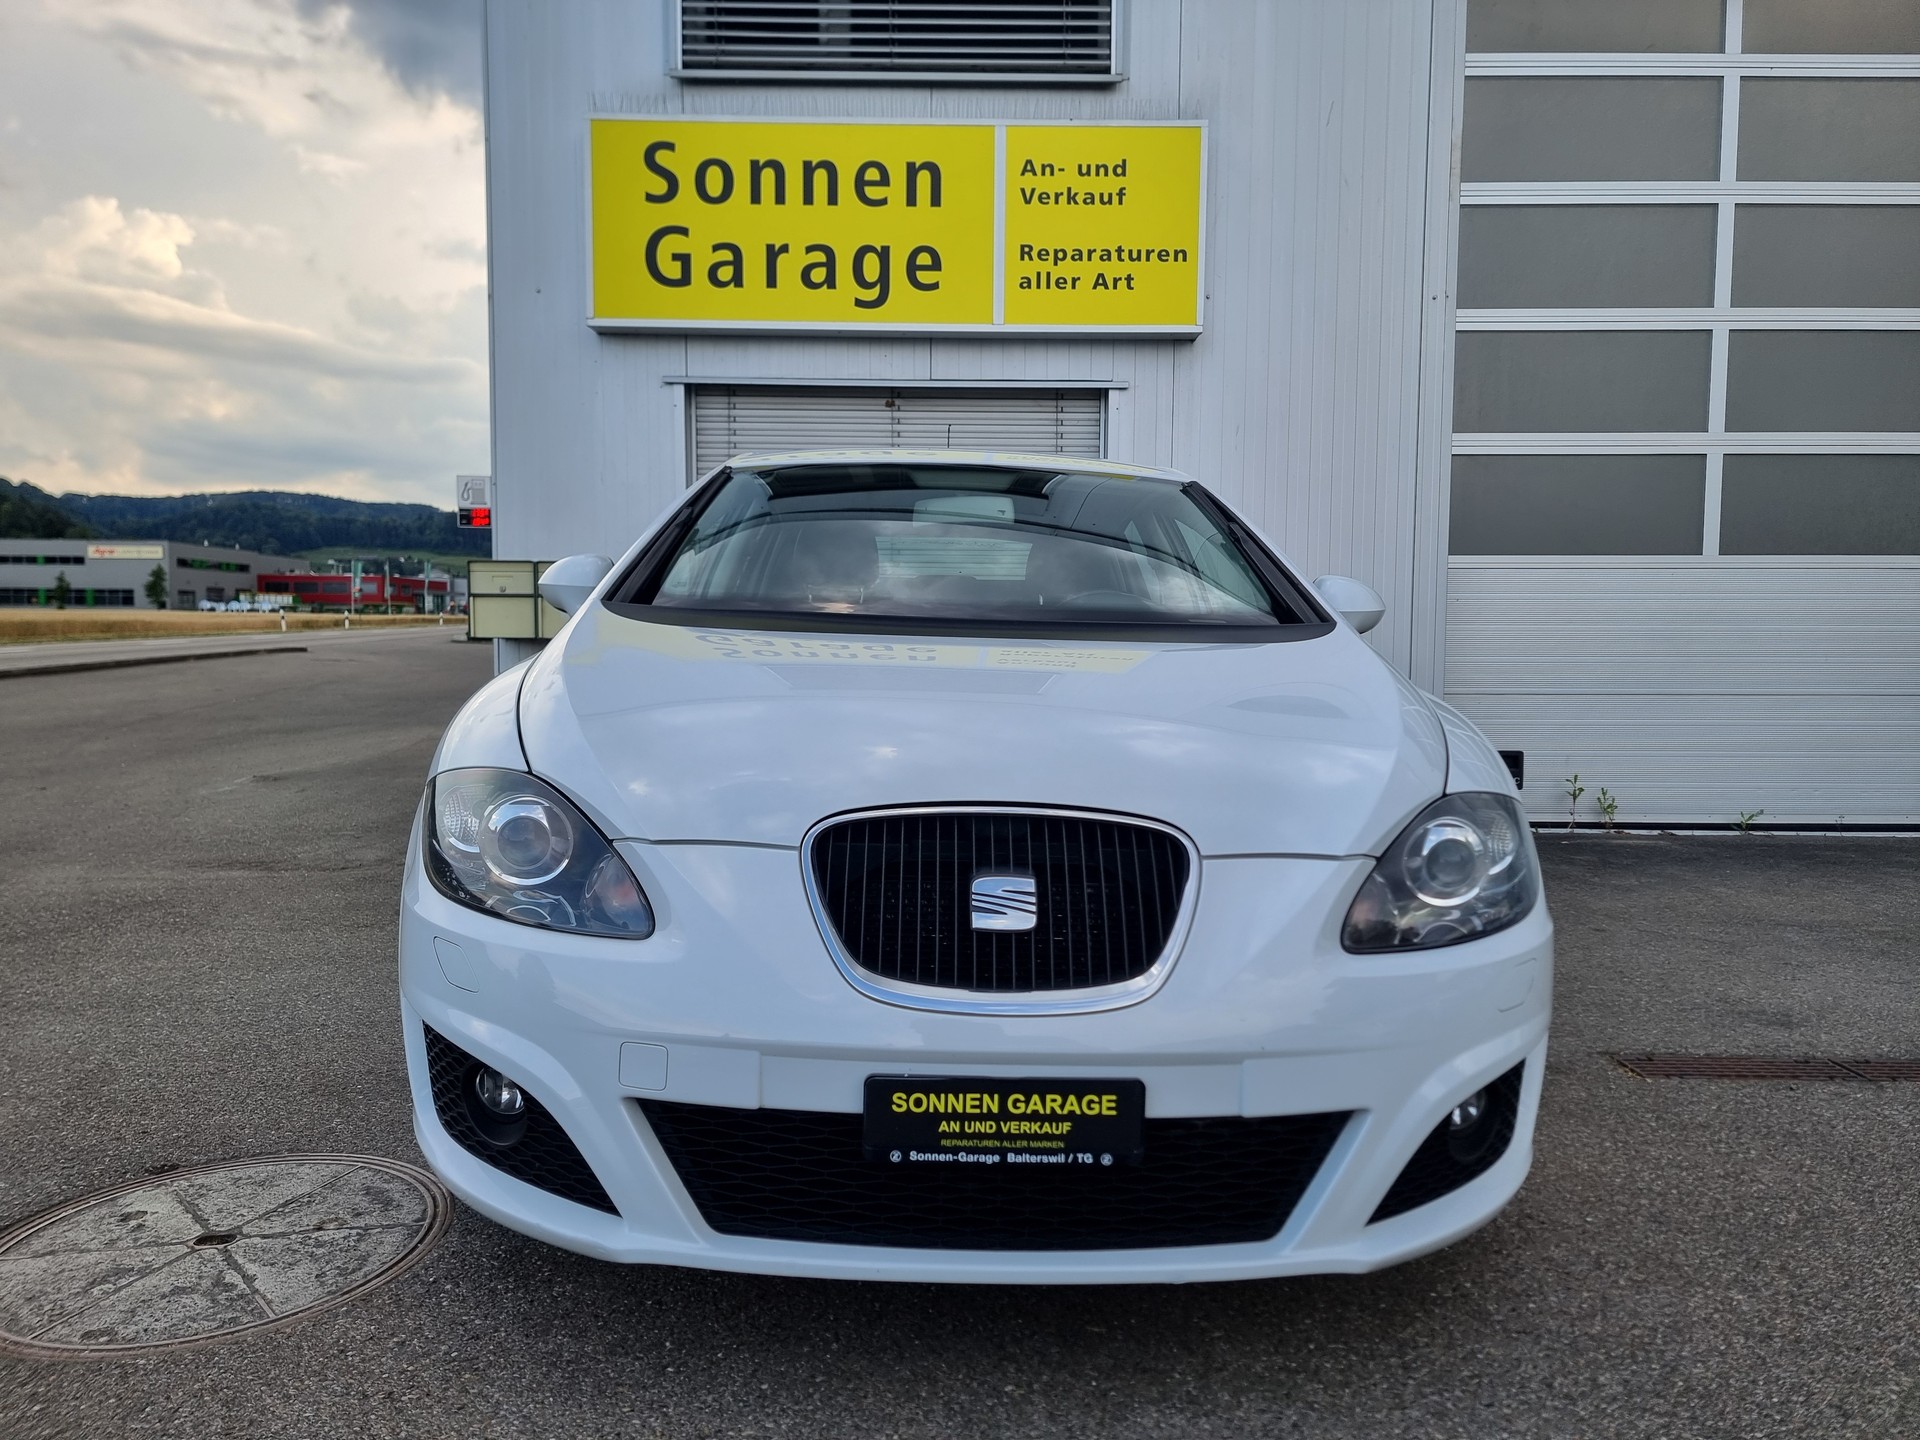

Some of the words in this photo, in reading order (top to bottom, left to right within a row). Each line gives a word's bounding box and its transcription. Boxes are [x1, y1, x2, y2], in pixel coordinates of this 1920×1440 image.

[643, 140, 942, 208] Sonnen
[1020, 159, 1066, 177] An-
[1077, 158, 1127, 178] und
[1019, 186, 1127, 206] Verkauf
[1019, 244, 1188, 266] Reparaturen
[644, 224, 943, 310] Garage
[1018, 271, 1081, 290] aller
[1091, 272, 1135, 291] Art
[891, 1092, 999, 1114] SONNEN
[1007, 1093, 1118, 1116] GARAGE
[938, 1120, 960, 1133] AN
[964, 1120, 997, 1134] UND
[1000, 1120, 1072, 1135] VERKAUF
[940, 1138, 1001, 1148] REPARATUREN
[1002, 1139, 1028, 1148] ALLER
[1029, 1140, 1065, 1149] MARKEN
[909, 1150, 1001, 1165] Sonnen-Garage
[1007, 1151, 1066, 1164] Balterswil
[1076, 1152, 1094, 1164] TG
